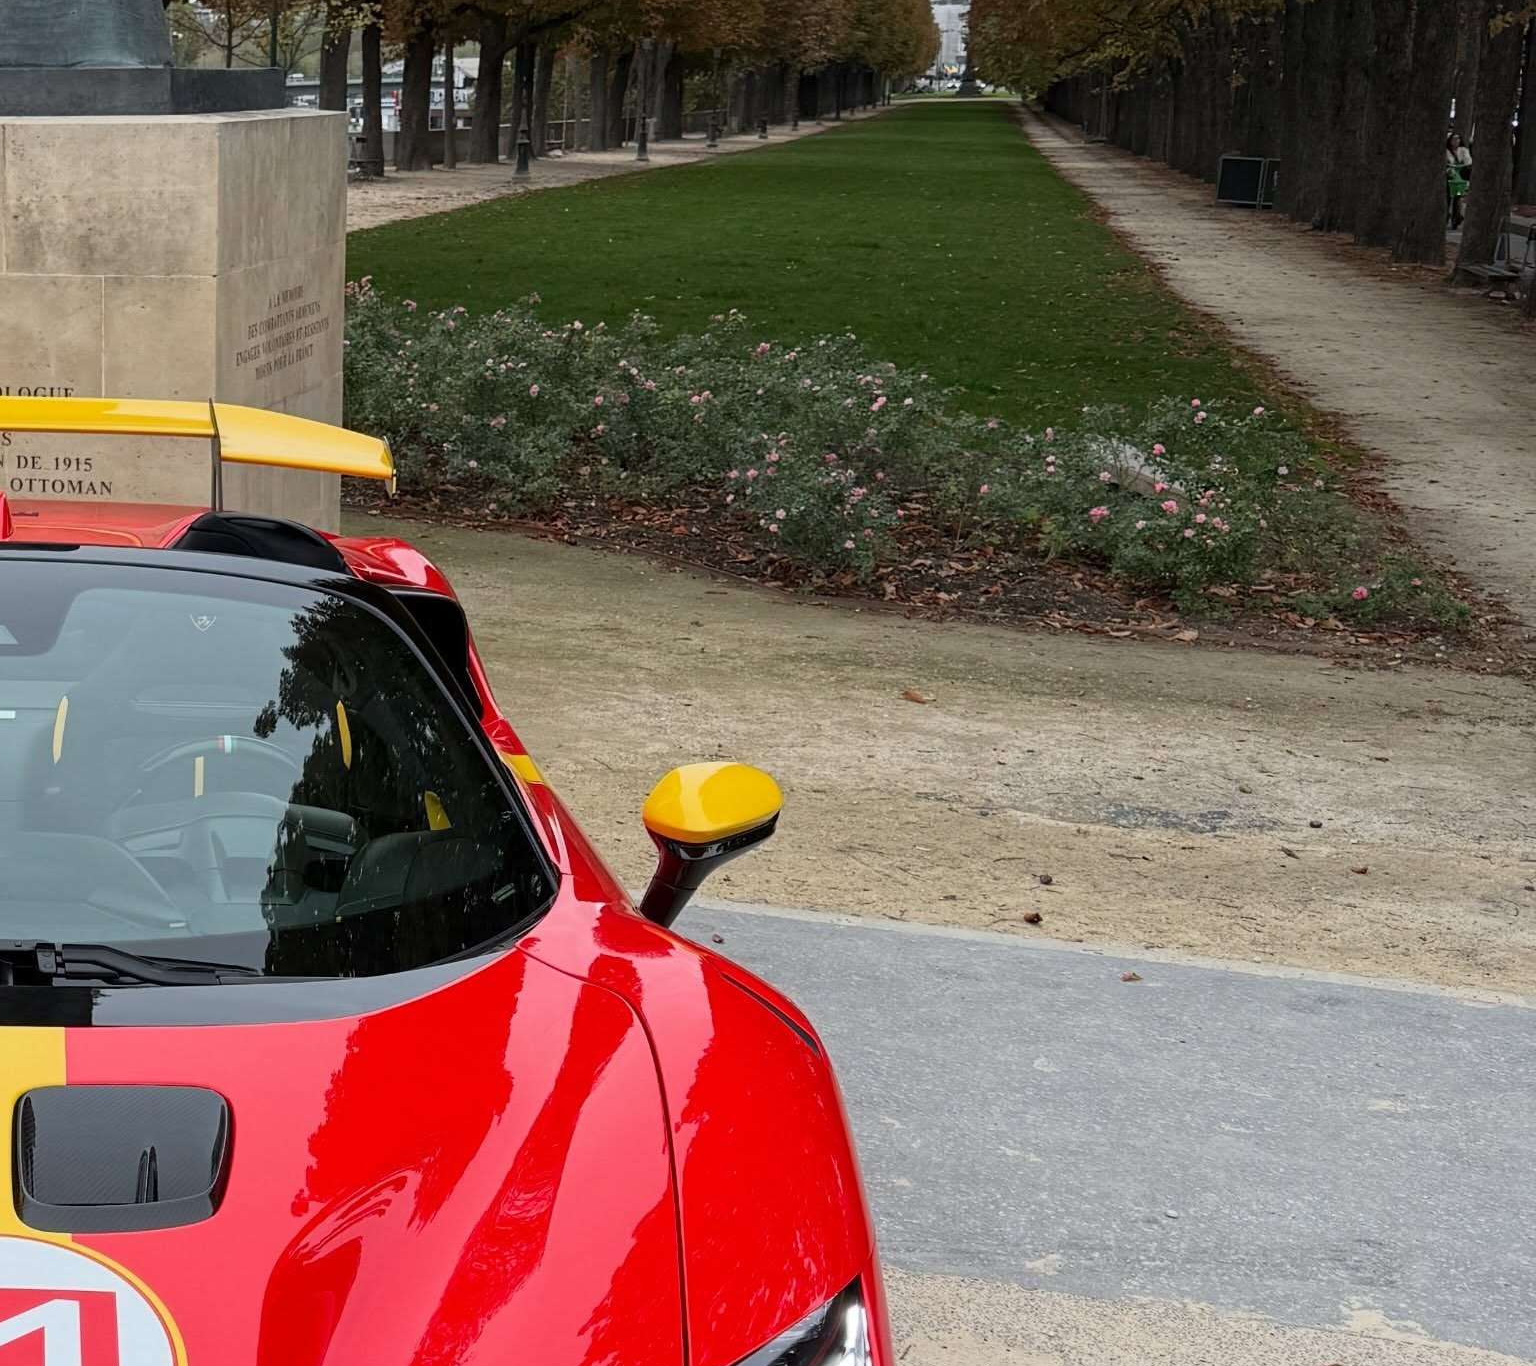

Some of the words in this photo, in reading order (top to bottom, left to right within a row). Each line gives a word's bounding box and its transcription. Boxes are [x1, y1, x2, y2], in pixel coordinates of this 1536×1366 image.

[16, 455, 42, 470] DE
[54, 456, 93, 472] 1915
[10, 477, 113, 495] OTTOMAN
